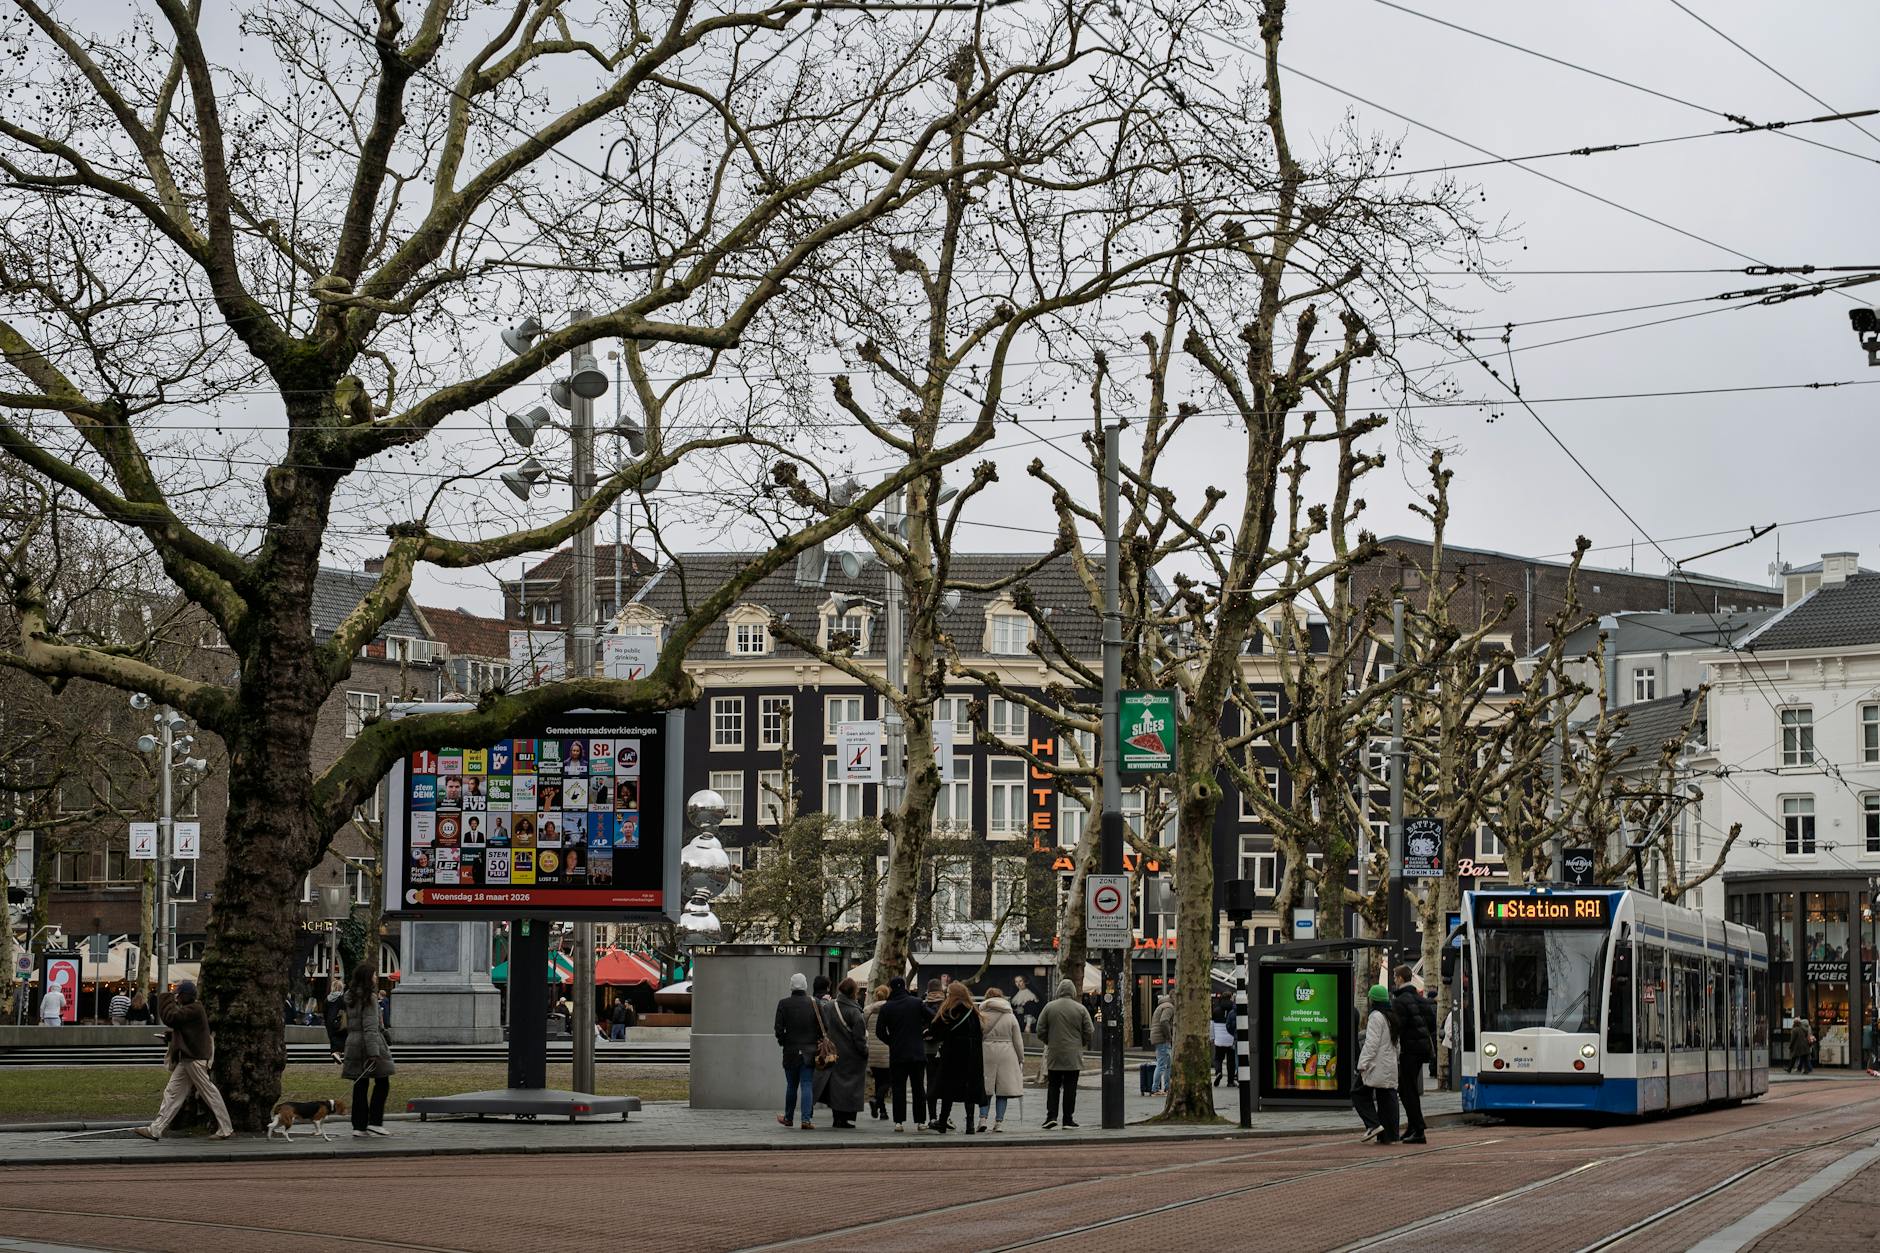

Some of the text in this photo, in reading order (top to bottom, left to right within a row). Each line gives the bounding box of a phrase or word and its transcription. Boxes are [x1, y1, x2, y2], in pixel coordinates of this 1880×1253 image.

[545, 726, 657, 736] Gemeenteraadsverkiezingen
[1131, 719, 1165, 736] SLICES
[415, 783, 433, 791] stem
[413, 791, 435, 799] DENK
[463, 801, 486, 811] FVD
[1406, 820, 1436, 834] BETTY
[438, 861, 458, 870] LEF
[489, 860, 506, 871] 50
[1457, 858, 1491, 877] Bar
[431, 892, 530, 902] Woensdag 18 maart 2026
[1487, 899, 1601, 917] 4 Station RAI
[771, 945, 808, 955] TOILET
[1807, 963, 1848, 971] FLYING
[1806, 972, 1848, 981] TIGER
[1296, 986, 1315, 995] fuze
[1296, 993, 1310, 1001] tea
